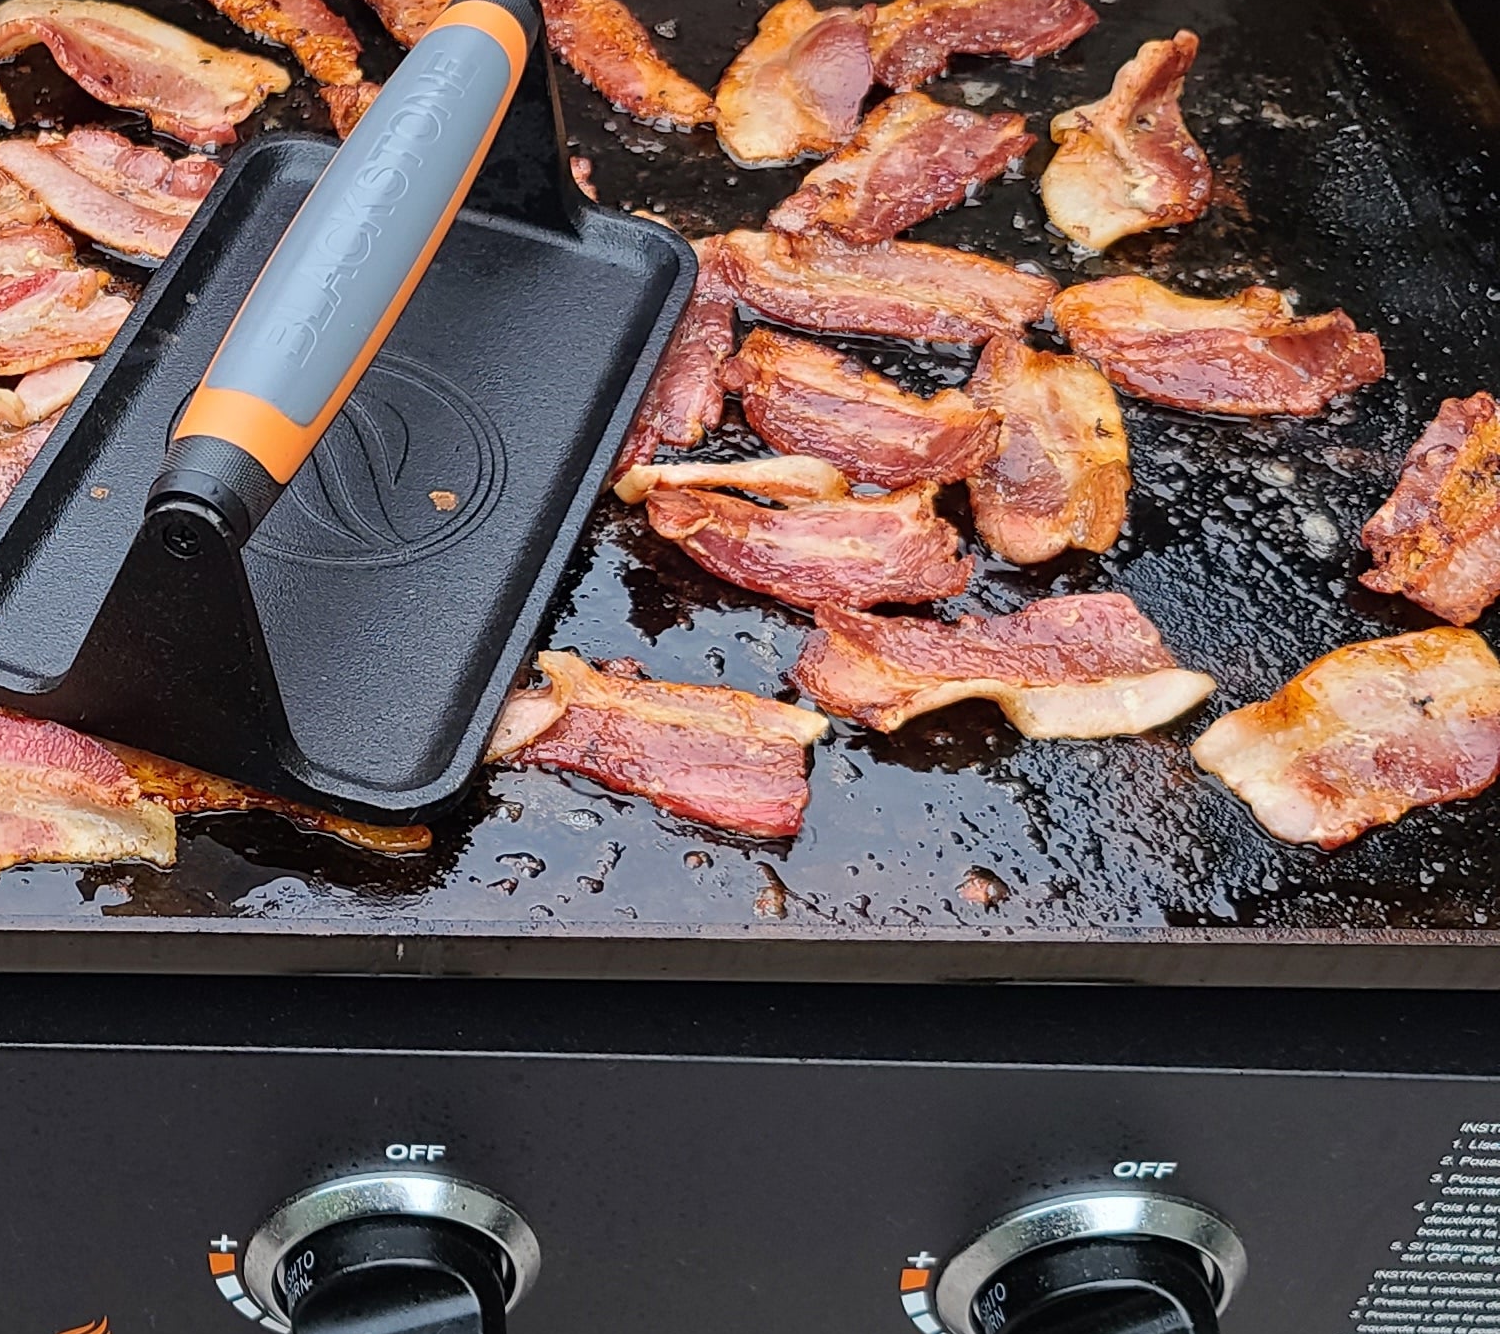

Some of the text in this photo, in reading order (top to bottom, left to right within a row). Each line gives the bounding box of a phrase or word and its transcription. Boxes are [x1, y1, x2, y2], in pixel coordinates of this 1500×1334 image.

[267, 50, 481, 369] BLACKSTONE
[1459, 1122, 1500, 1134] INST
[384, 1143, 447, 1162] OFF
[1111, 1160, 1179, 1180] OFF
[1374, 1270, 1494, 1283] INSTRUCCIONES
